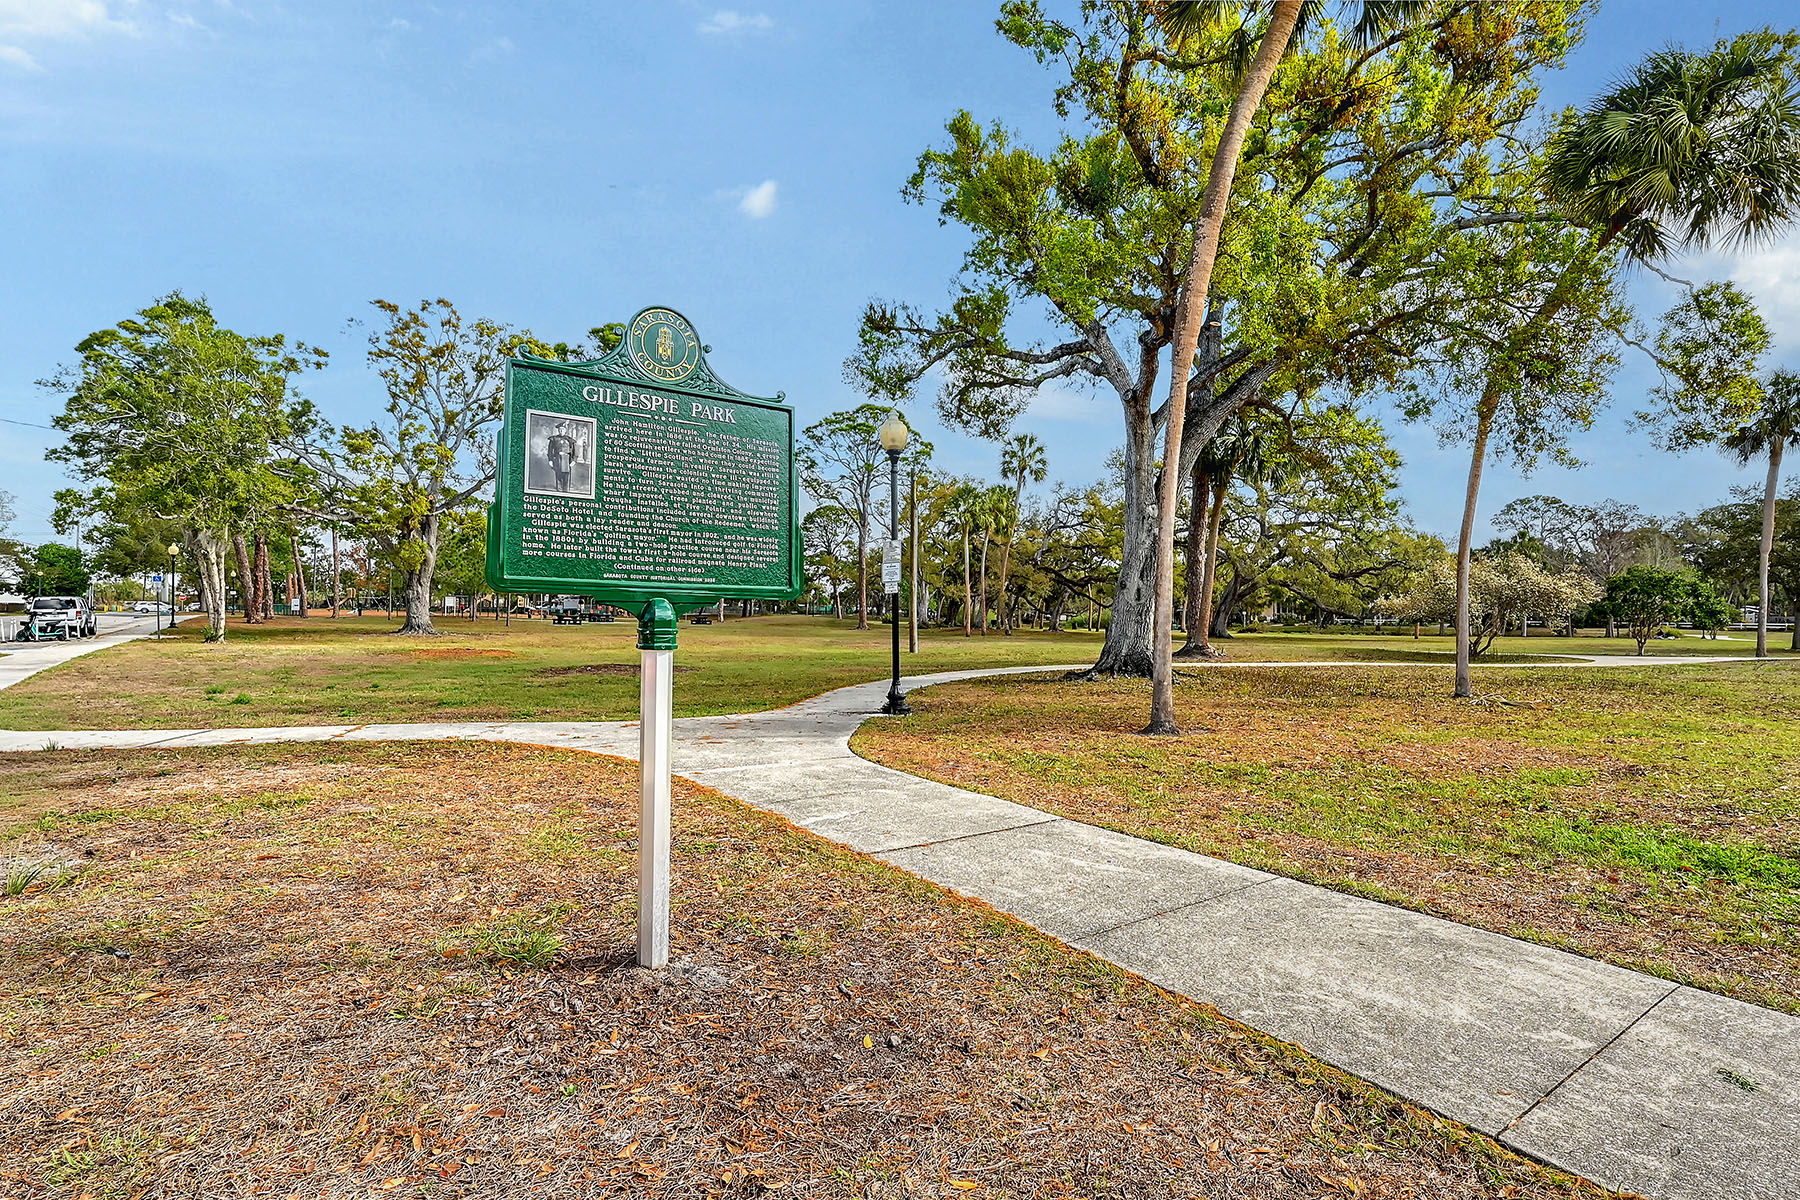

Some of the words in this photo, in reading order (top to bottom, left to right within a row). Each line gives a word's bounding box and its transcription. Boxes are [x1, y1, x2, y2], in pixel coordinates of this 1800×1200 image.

[633, 312, 696, 348] SARASOTA
[637, 352, 692, 378] COUNTY
[582, 386, 679, 415] GILLESPIE
[690, 402, 737, 424] PARK
[605, 423, 633, 433] arrived
[636, 427, 653, 436] here
[612, 417, 629, 426] John
[633, 420, 665, 431] Hamilton
[629, 434, 667, 446] rejuvenate
[613, 446, 629, 454] find
[624, 440, 653, 450] Scottish
[654, 444, 680, 453] settlers
[604, 453, 644, 464] prosperous
[604, 459, 624, 468] harsh
[626, 462, 663, 472] wilderness
[604, 474, 625, 482] ments
[638, 477, 654, 485] turn
[658, 479, 688, 489] Sarasota
[641, 470, 673, 481] Gillespie
[603, 488, 625, 496] wharf
[632, 484, 658, 492] streets
[603, 495, 632, 505] troughs
[637, 498, 669, 507] installed
[540, 504, 569, 513] DeSoto
[572, 507, 594, 515] Hotel
[617, 511, 649, 521] founding
[568, 499, 602, 510] personal
[604, 502, 654, 513] contributions
[656, 507, 686, 516] included
[523, 510, 551, 519] served
[565, 514, 583, 522] both
[609, 517, 635, 526] reader
[523, 526, 549, 534] known
[532, 519, 567, 529] Gillespie
[585, 523, 613, 531] elected
[552, 535, 575, 543] 1880s
[592, 538, 624, 547] building
[563, 543, 583, 551] later
[585, 544, 603, 552] built
[589, 552, 617, 560] Florida
[613, 563, 654, 571] (Continued
